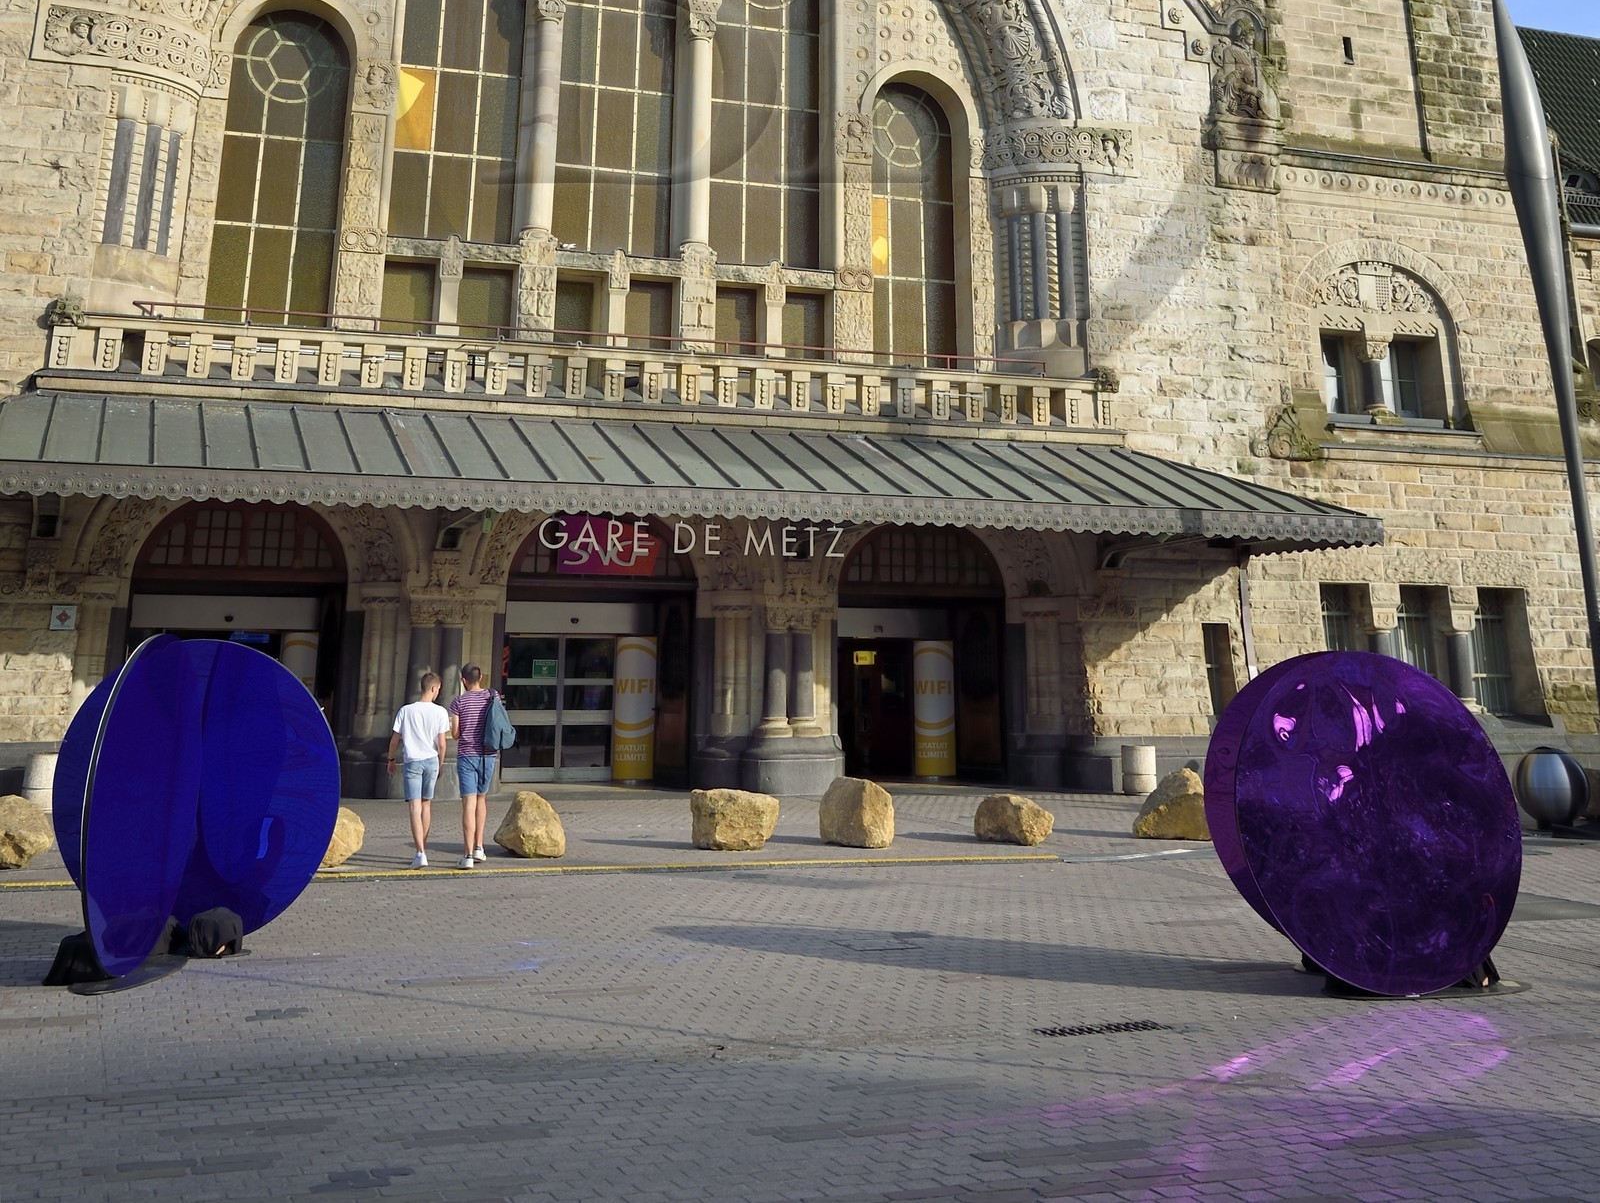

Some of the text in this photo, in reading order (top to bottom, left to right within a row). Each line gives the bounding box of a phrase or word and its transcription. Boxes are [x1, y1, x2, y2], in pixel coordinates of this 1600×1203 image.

[539, 519, 845, 558] GARE DE METZ
[615, 679, 655, 694] WIFI
[914, 680, 952, 695] WIFI
[615, 744, 647, 752] GRATUIT
